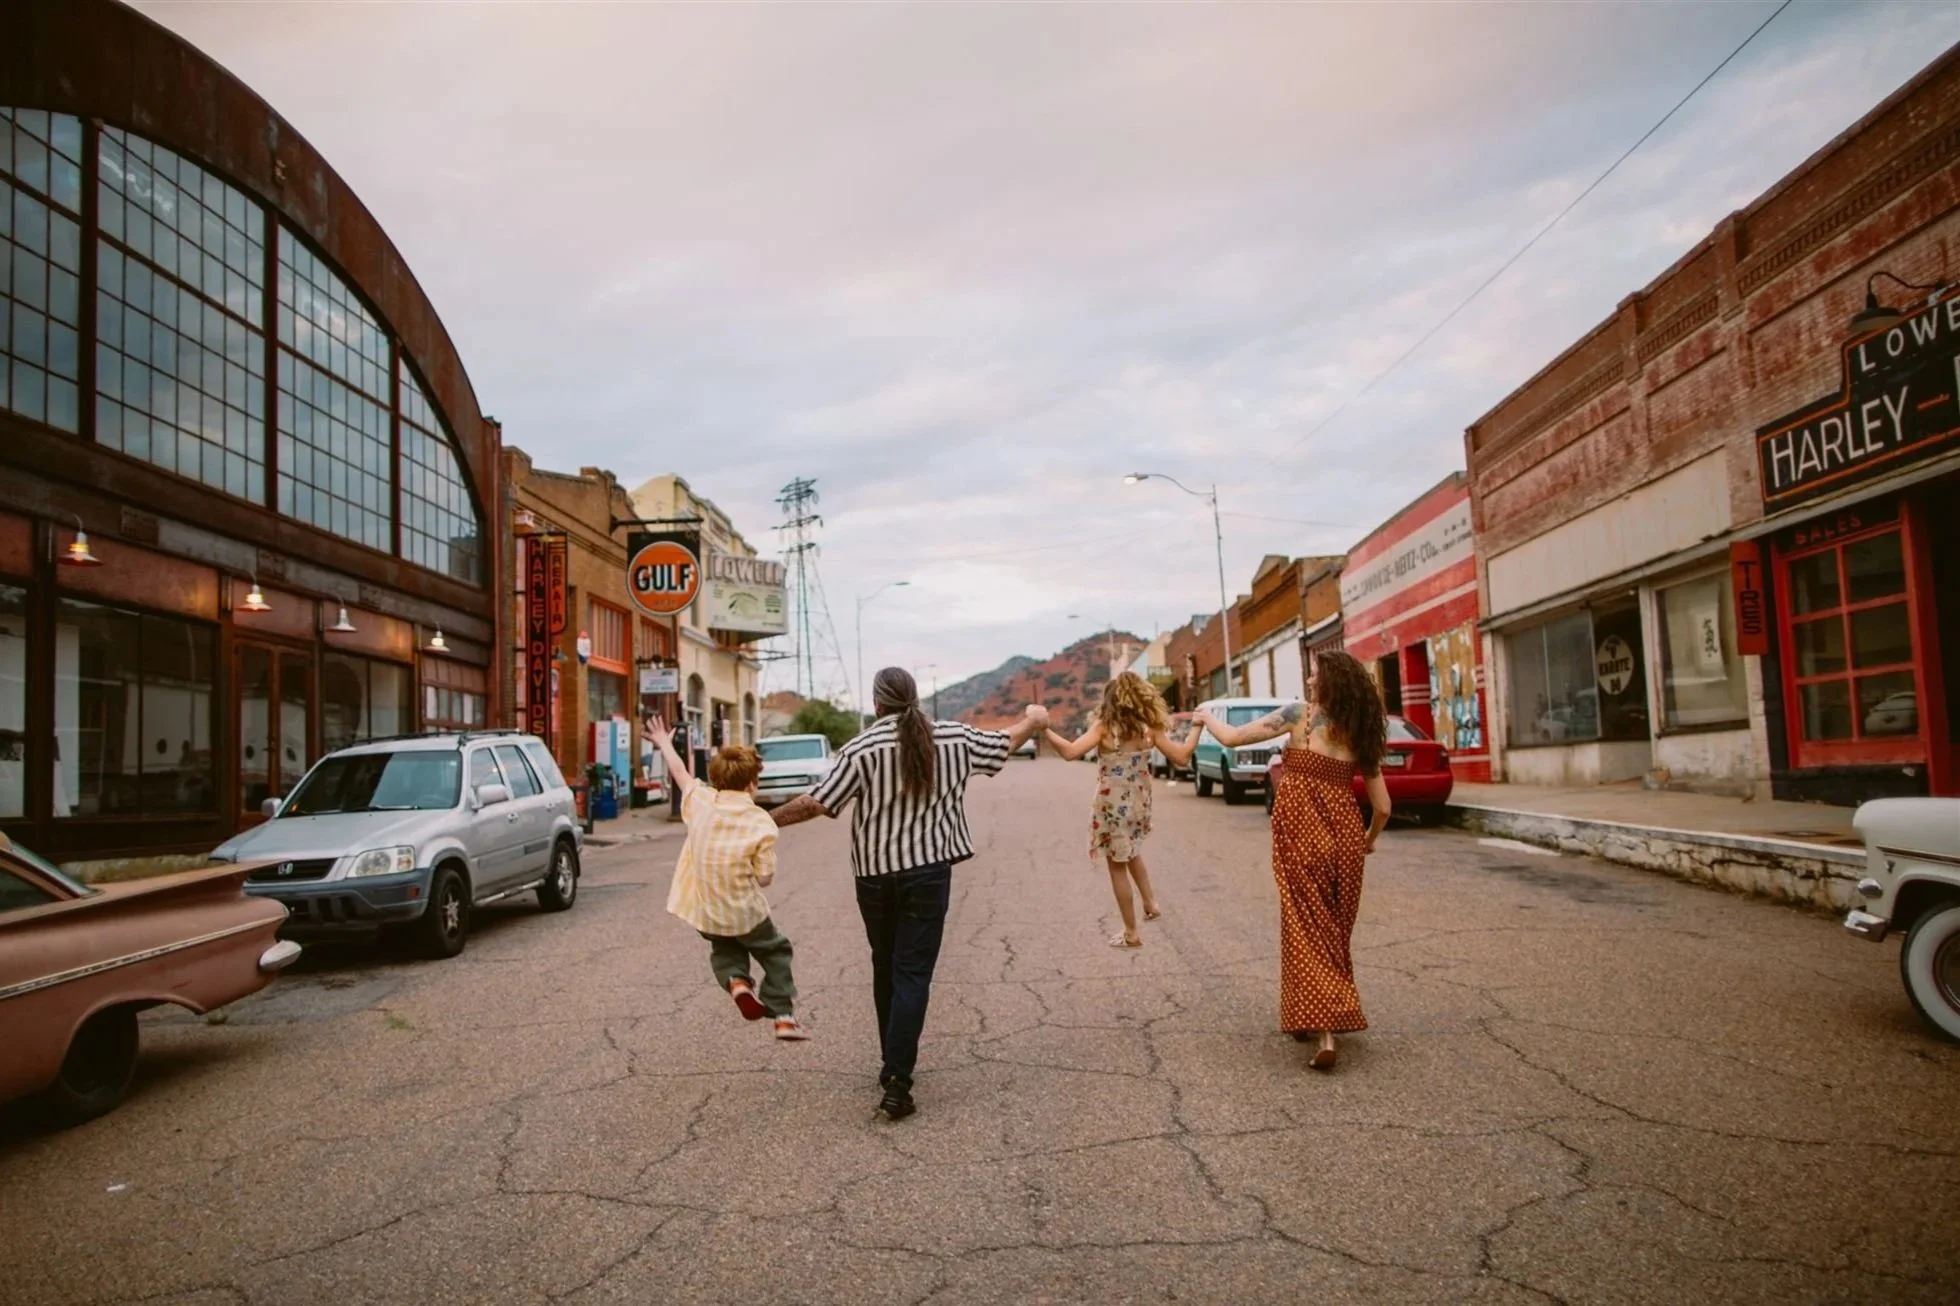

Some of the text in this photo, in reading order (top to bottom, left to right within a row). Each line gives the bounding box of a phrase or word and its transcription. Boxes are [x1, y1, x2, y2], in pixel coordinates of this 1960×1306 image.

[531, 539, 545, 633] HARLEY
[552, 554, 563, 625] REPAIR
[634, 563, 695, 593] GULF
[711, 555, 783, 587] LOWELL
